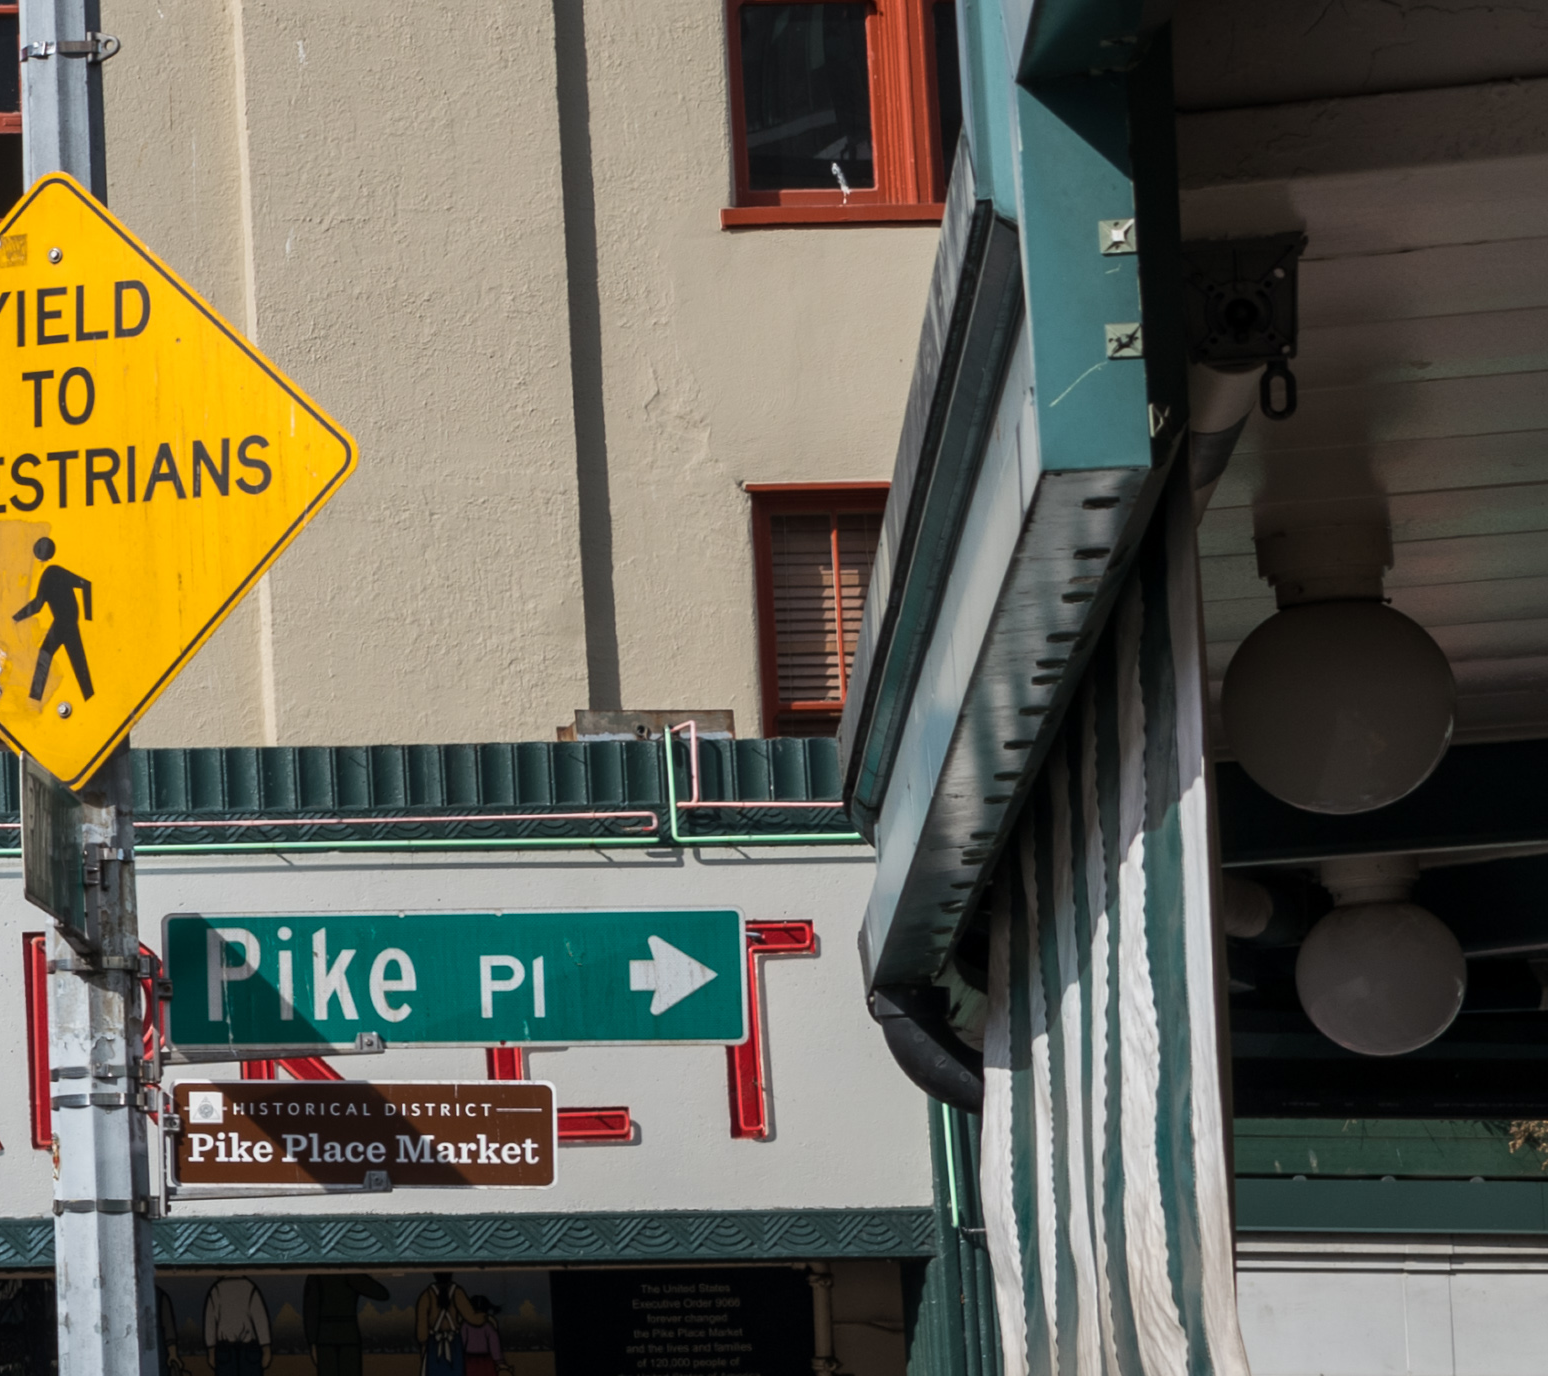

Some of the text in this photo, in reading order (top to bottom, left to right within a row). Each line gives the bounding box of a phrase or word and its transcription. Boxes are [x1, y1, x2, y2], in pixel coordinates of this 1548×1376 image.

[21, 365, 97, 427] TO
[205, 927, 547, 1024] Pike Pl
[232, 1102, 494, 1117] HISTORICAL DISTRICT
[187, 1131, 540, 1165] Pike Place Market
[662, 1282, 731, 1293] United States
[631, 1297, 713, 1310] Executive Order
[646, 1312, 729, 1325] forever changed
[651, 1326, 743, 1338] Pike Place Market
[666, 1341, 753, 1353] lives families
[692, 1358, 727, 1369] people
